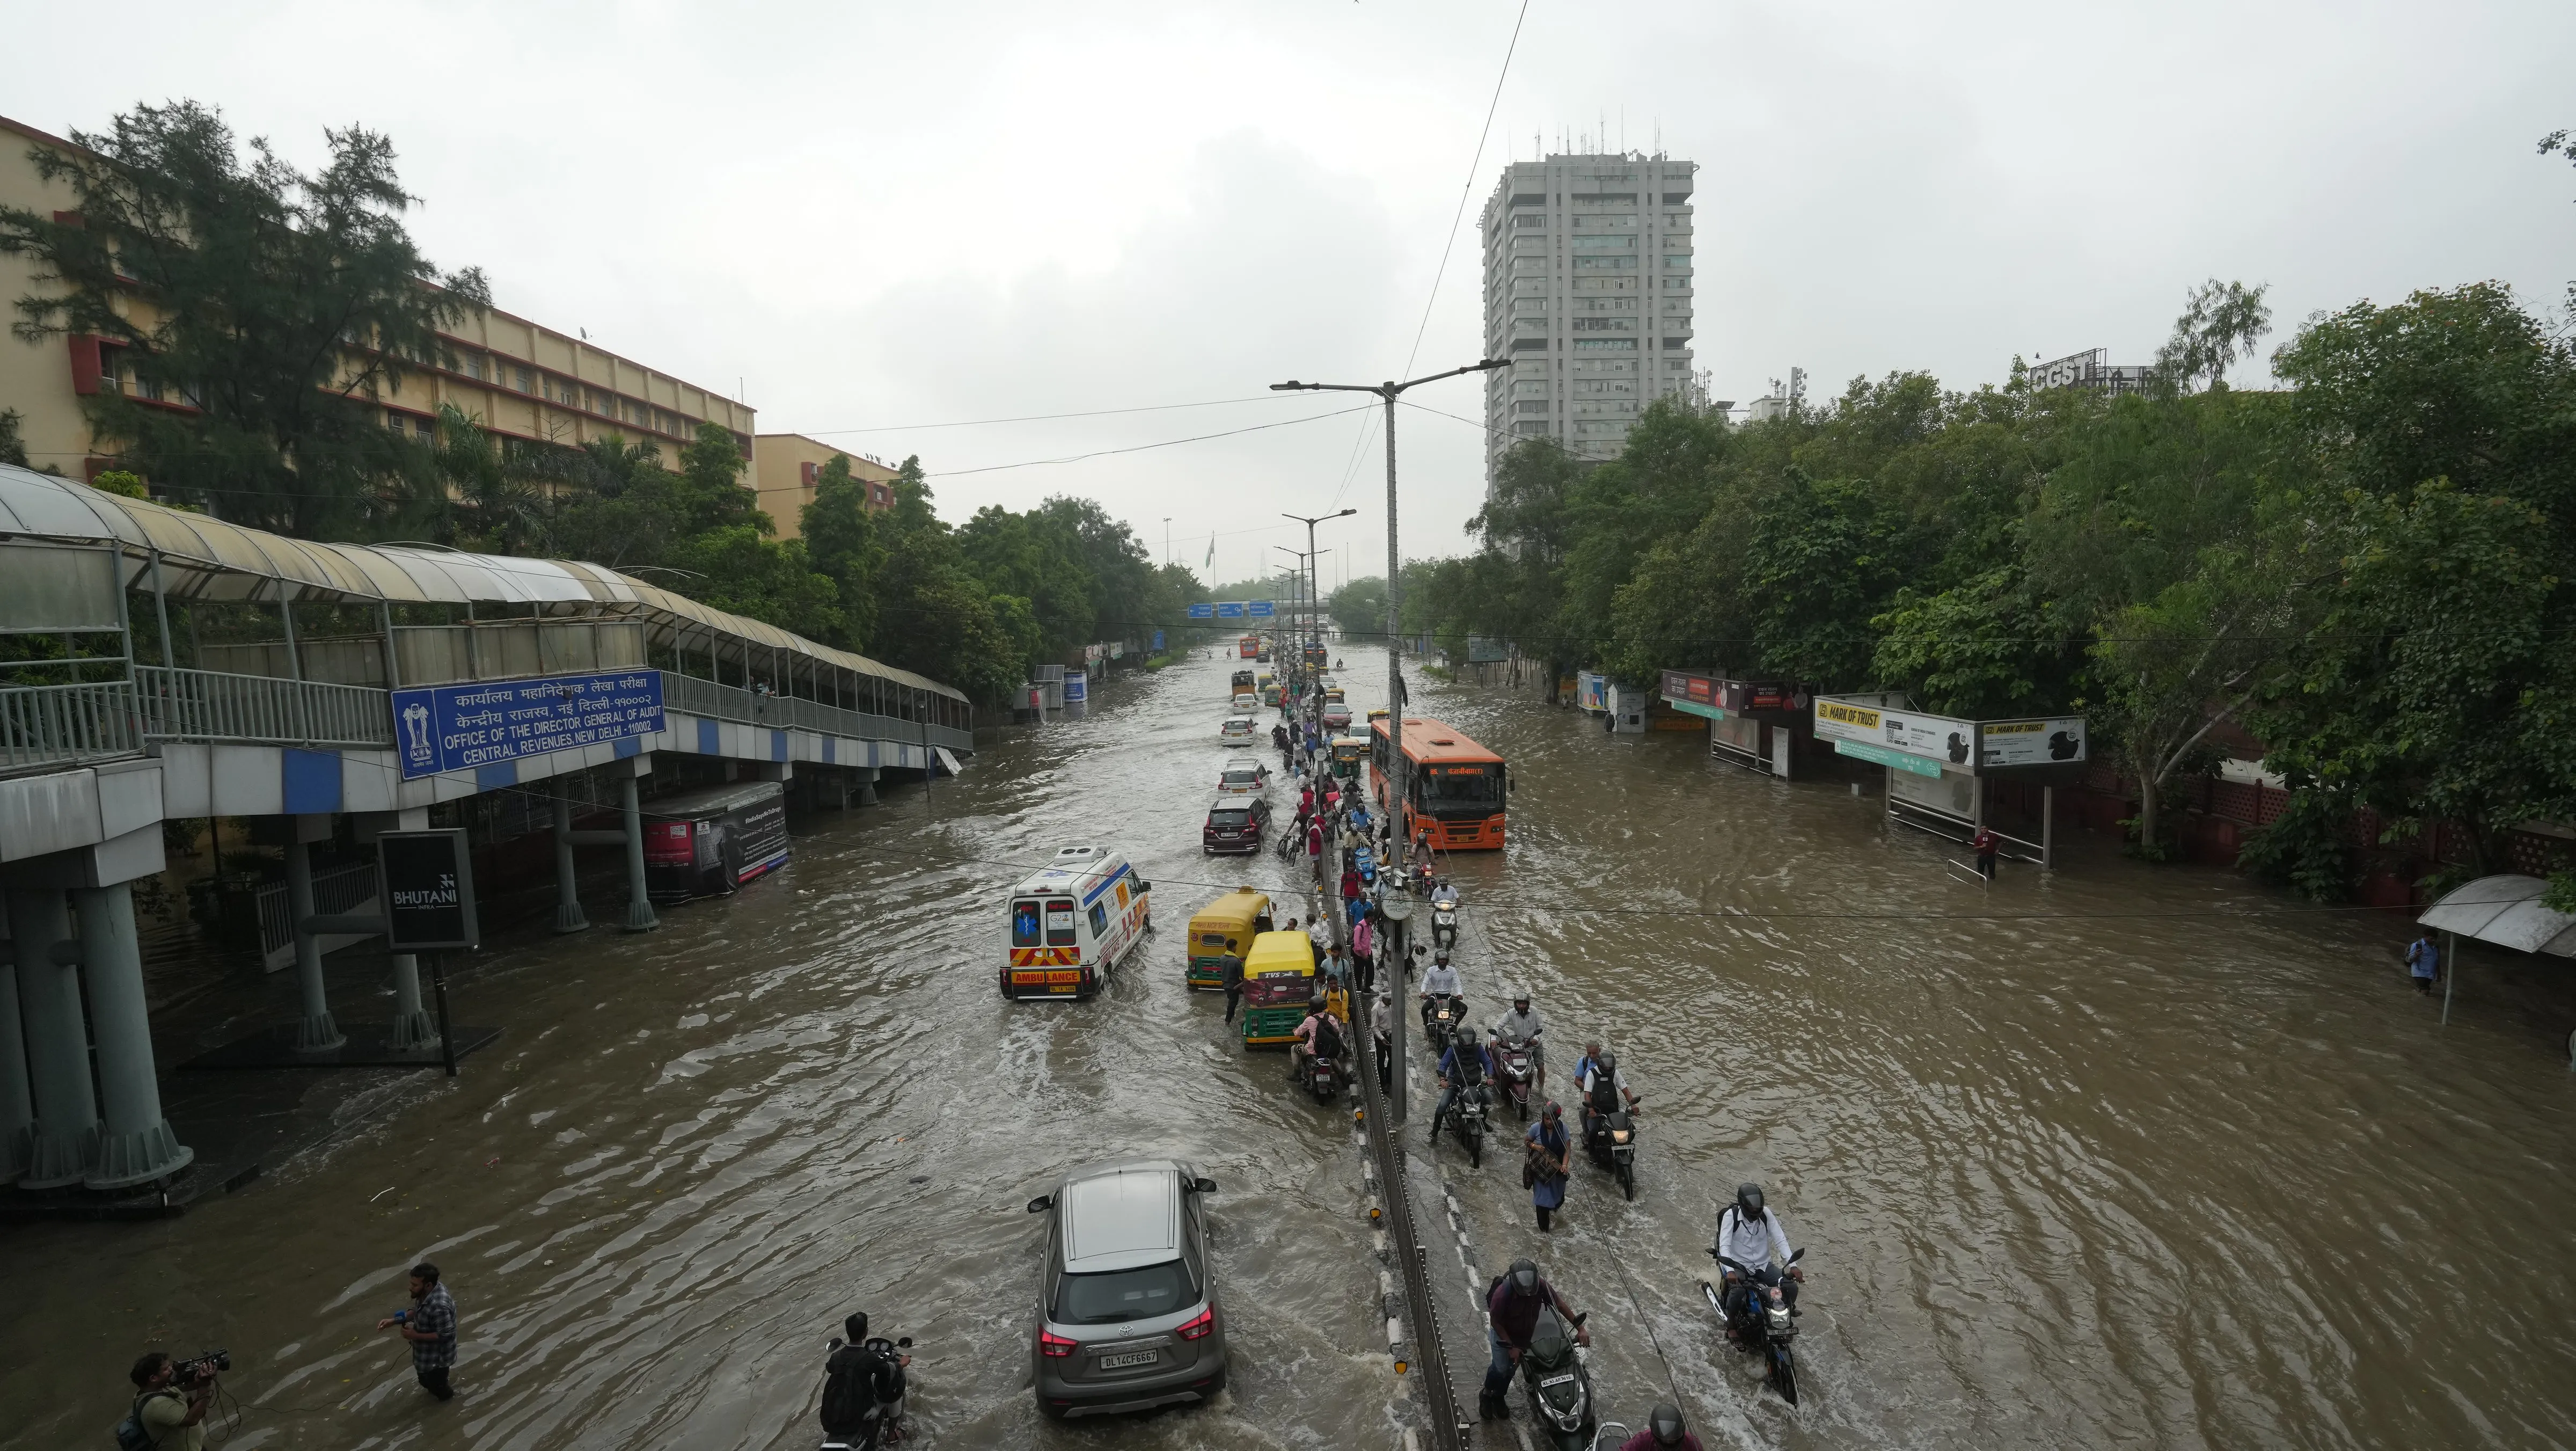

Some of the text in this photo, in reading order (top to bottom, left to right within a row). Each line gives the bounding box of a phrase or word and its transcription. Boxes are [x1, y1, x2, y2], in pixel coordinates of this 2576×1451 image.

[2031, 354, 2092, 392] CGST
[455, 689, 513, 706] कार्यालय
[590, 679, 614, 692] लेखा
[619, 676, 647, 689] परीक्षा
[444, 705, 661, 749] OFFICE OF THE DIRECTOR GENERAL OF AUDIT
[455, 710, 502, 728] केन्द्रीय
[508, 706, 553, 721] राजस्व,
[557, 700, 573, 715] नई
[1829, 706, 1878, 726] MARK OF TRUST
[463, 743, 517, 764] CENTRAL
[520, 733, 574, 754] REVENUES,
[575, 729, 595, 743] NEW
[599, 725, 622, 739] DELHI
[628, 720, 652, 734] 110002
[1996, 725, 2013, 733] MARK
[745, 806, 781, 824] #IndiaSaysNoToDrugs
[394, 889, 457, 904] BHUTANI
[1101, 940, 1119, 969] AMBULANCE
[1106, 1352, 1155, 1367] DL14CF6667
